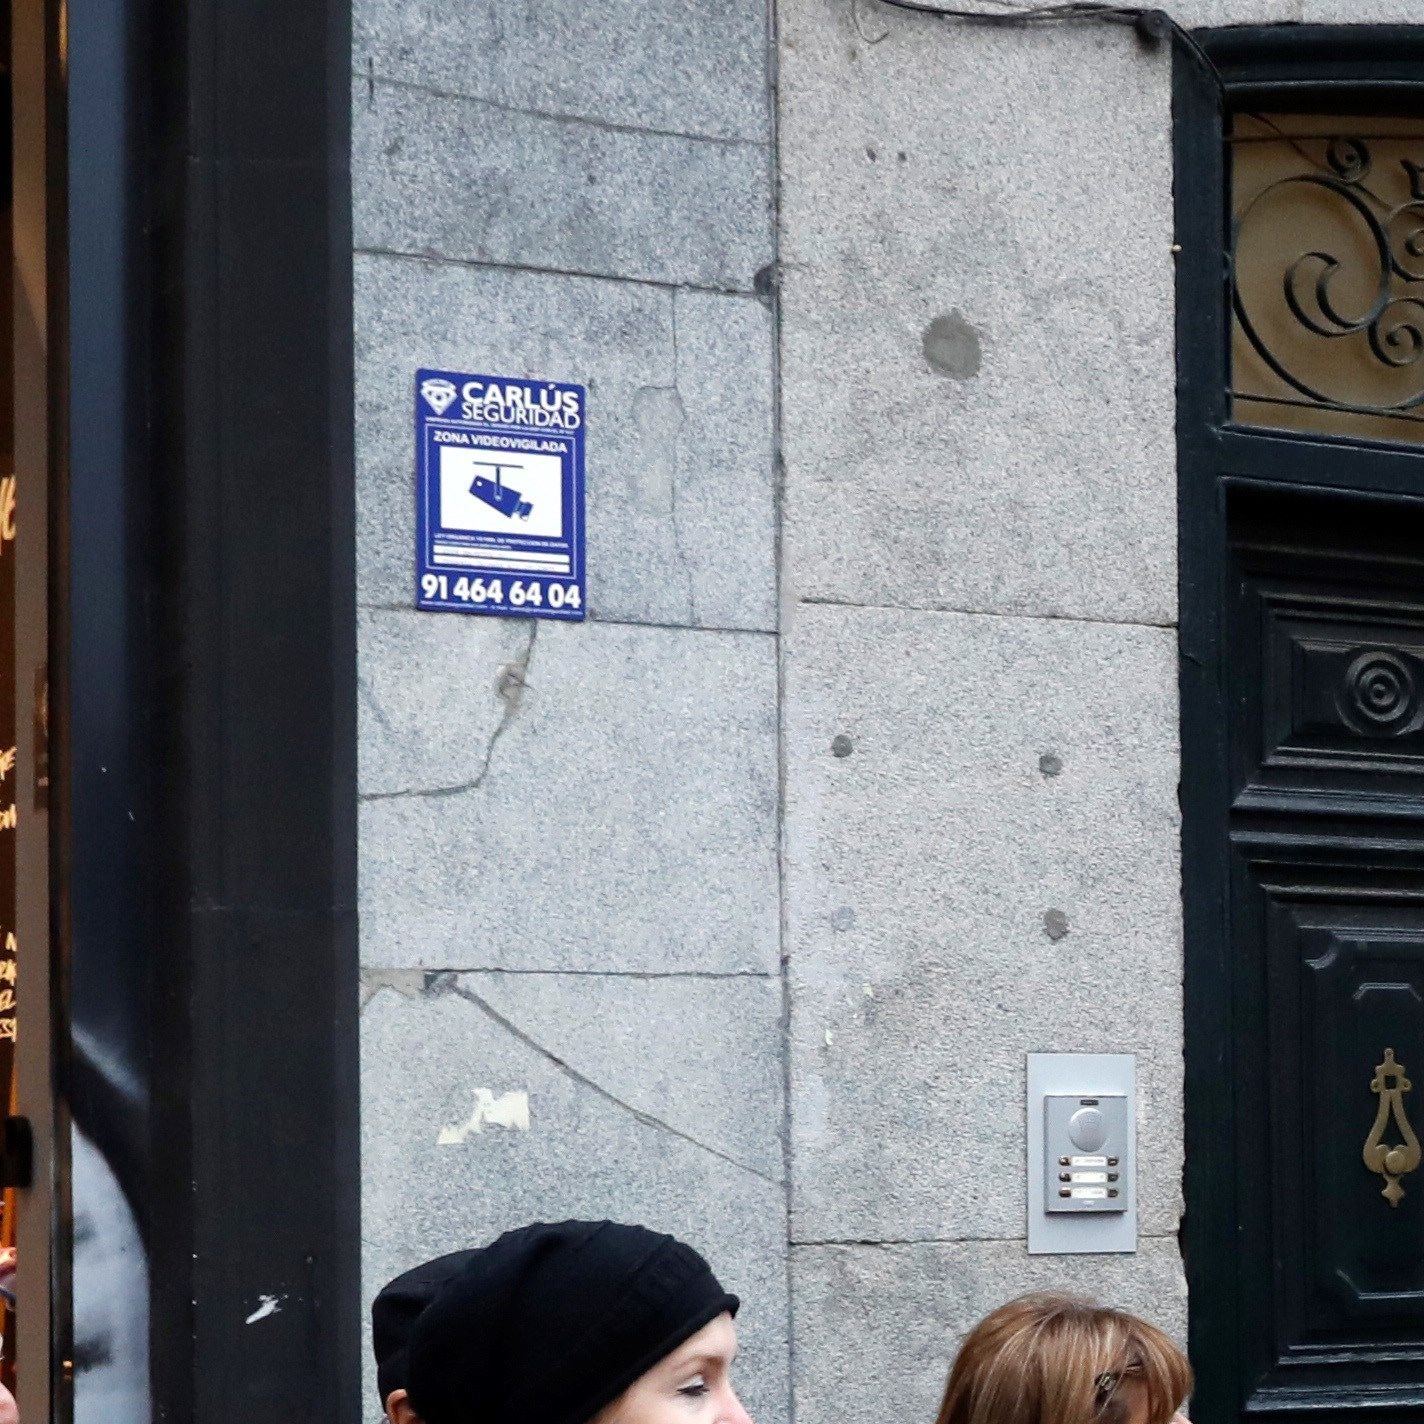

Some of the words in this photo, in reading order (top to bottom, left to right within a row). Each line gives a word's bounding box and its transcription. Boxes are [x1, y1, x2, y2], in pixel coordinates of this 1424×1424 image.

[462, 382, 580, 414] CARLÚS
[462, 402, 581, 429] SEGURIDAD
[433, 431, 471, 445] ZONA
[472, 435, 568, 453] VIDEOVIGILADA
[421, 574, 447, 599] 91
[453, 576, 503, 605] 464
[509, 581, 542, 606] 64
[548, 584, 581, 609] 04
